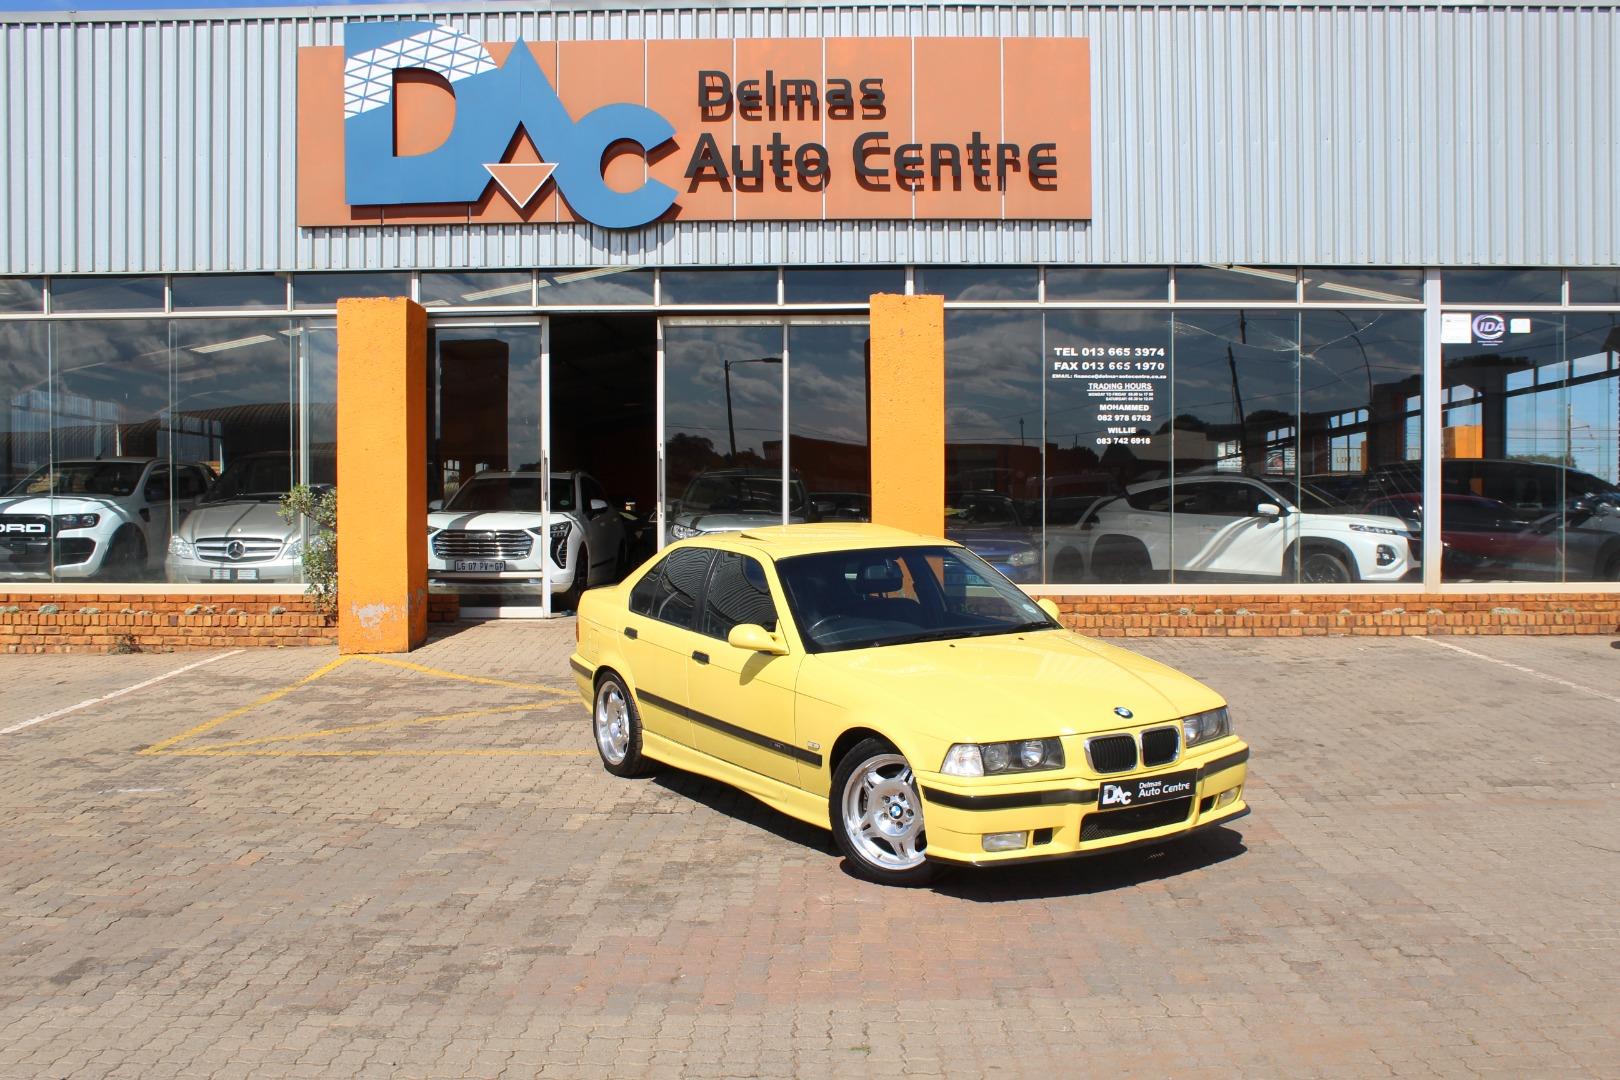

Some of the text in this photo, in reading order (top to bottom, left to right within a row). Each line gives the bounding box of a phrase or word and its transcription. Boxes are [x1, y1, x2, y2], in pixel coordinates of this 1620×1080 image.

[698, 70, 886, 108] Delmas
[344, 21, 679, 229] DAC
[684, 131, 1057, 178] Auto Centre
[1480, 321, 1505, 332] IDA
[1054, 347, 1165, 356] TEL 013 665 3974
[1054, 362, 1165, 370] FAX 013 665 1970
[1138, 782, 1190, 798] Auto Centre
[1139, 780, 1162, 789] Delmas
[1102, 784, 1131, 804] DAC
